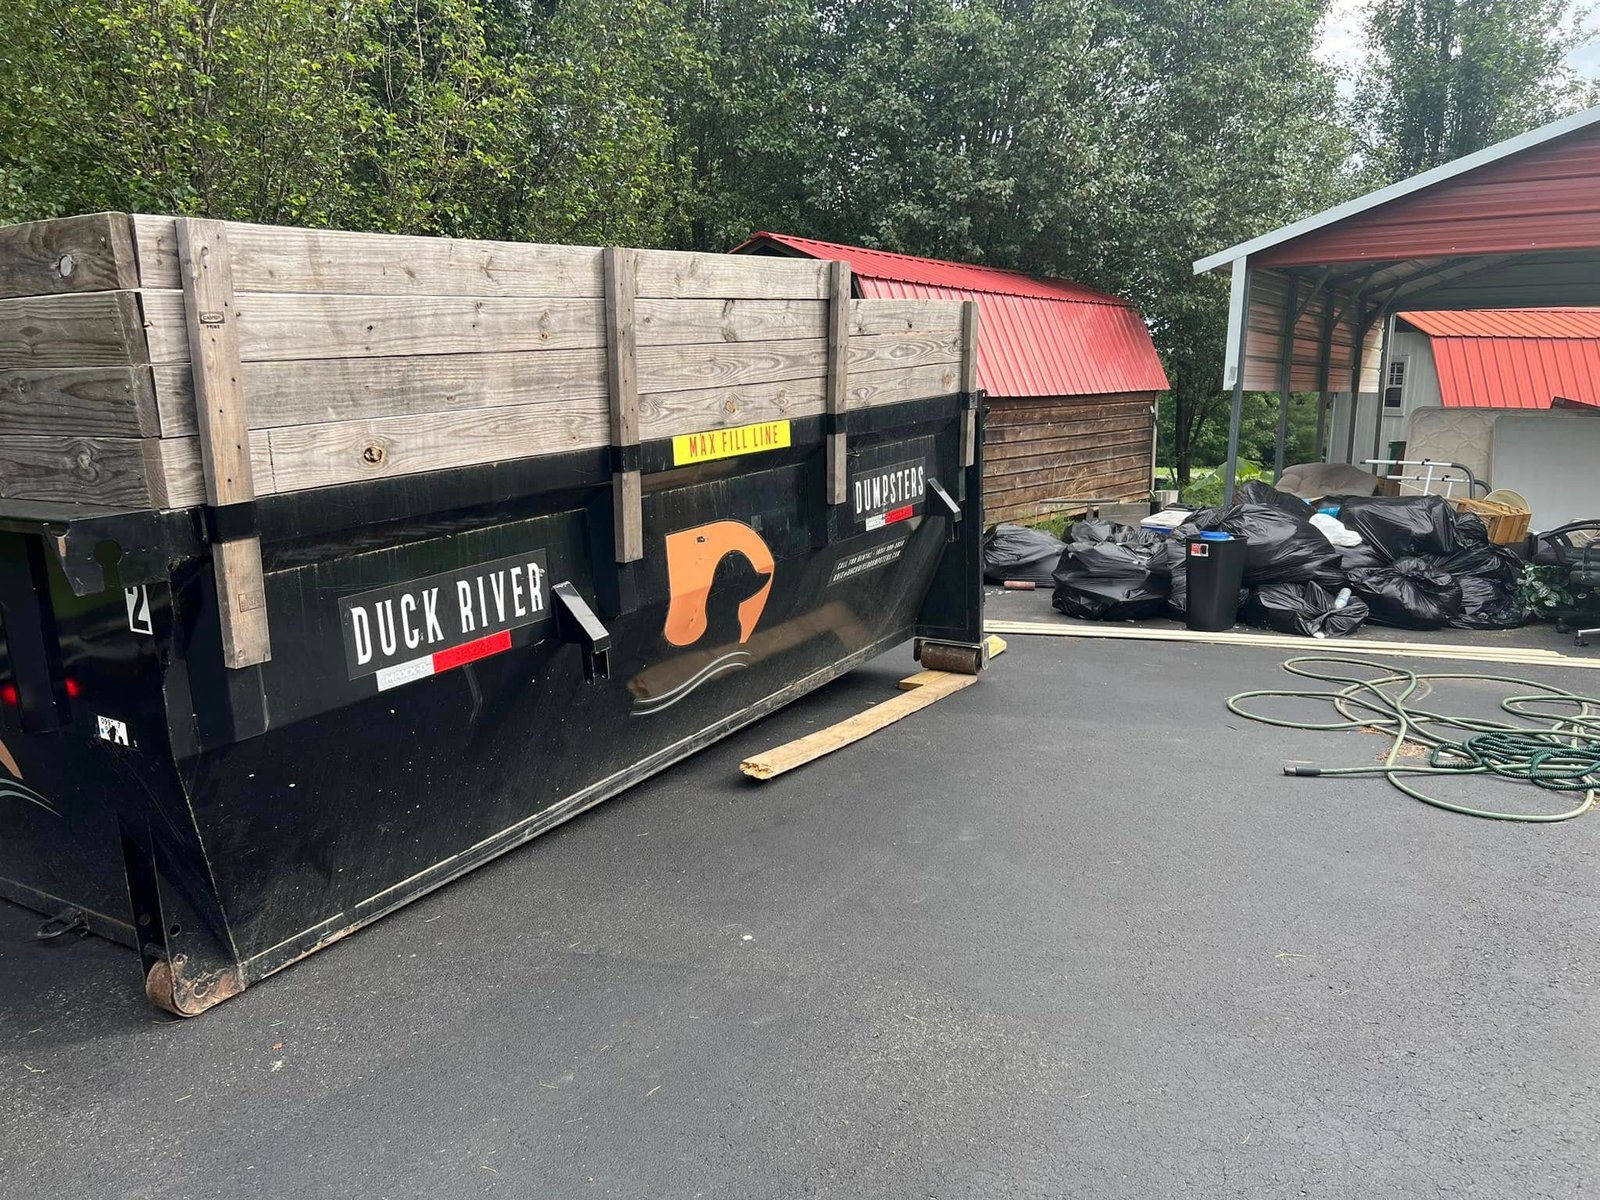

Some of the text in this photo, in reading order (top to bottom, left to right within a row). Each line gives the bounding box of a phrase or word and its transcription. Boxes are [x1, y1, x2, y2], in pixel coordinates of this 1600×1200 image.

[689, 424, 778, 458] MAX FILL LINE
[855, 465, 924, 514] DUMPSTERS
[350, 562, 544, 666] DUCK RIVER
